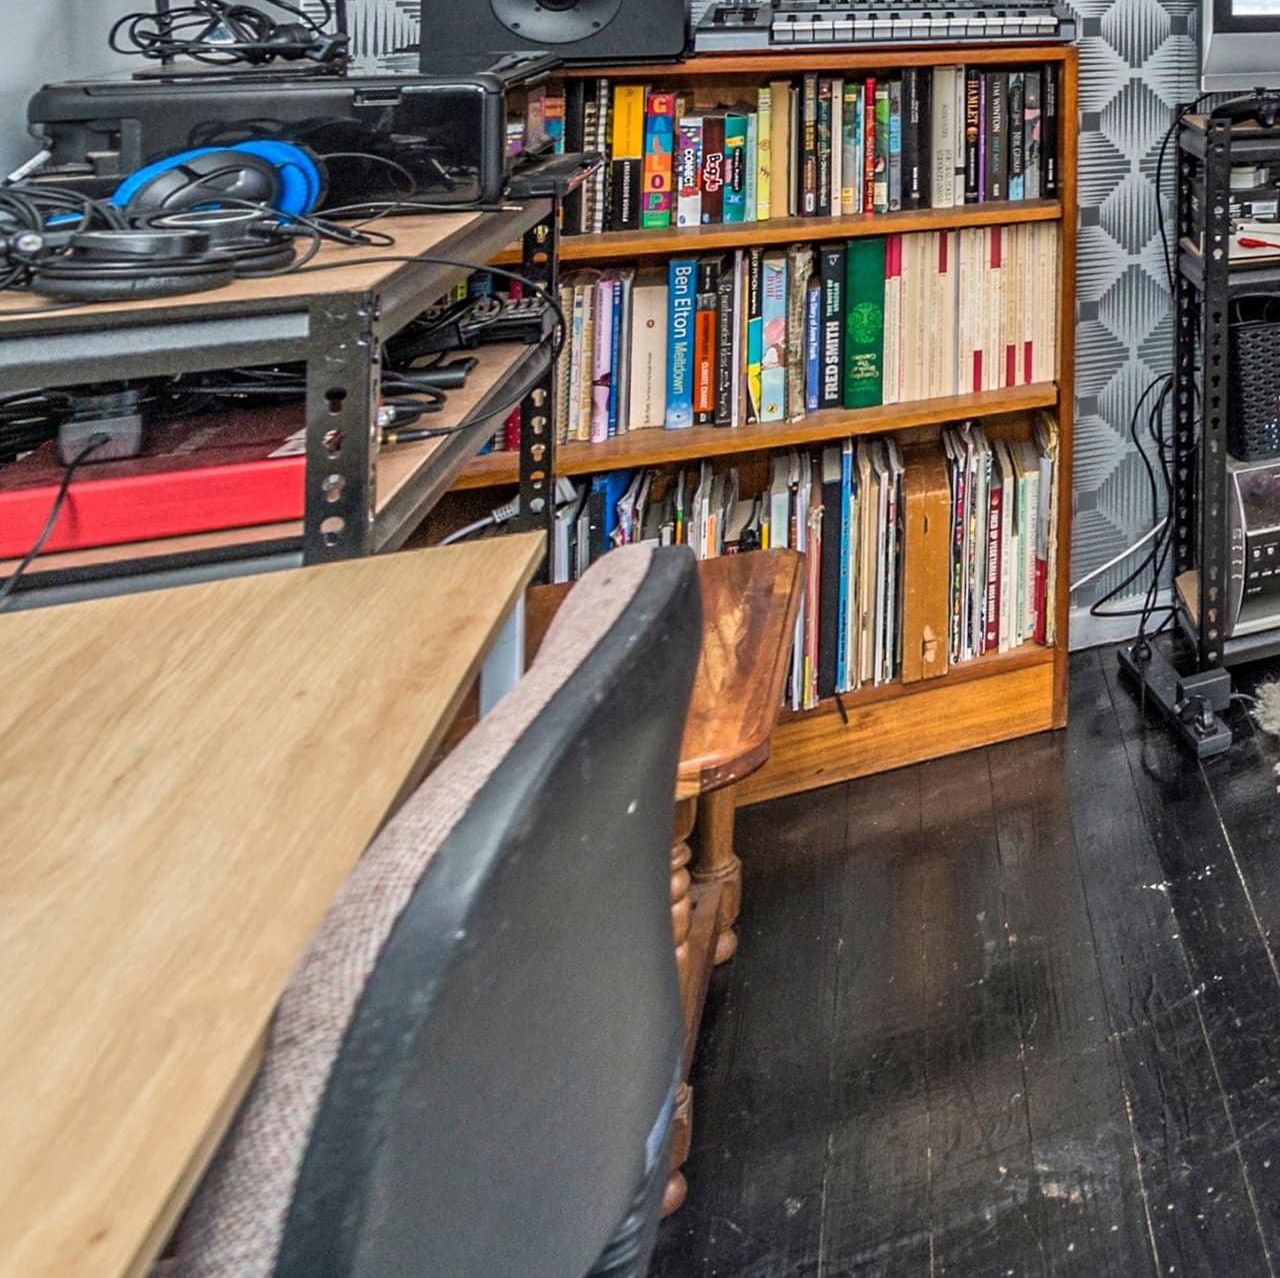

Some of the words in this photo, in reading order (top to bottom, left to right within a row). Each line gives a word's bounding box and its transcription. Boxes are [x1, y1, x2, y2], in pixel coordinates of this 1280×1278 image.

[967, 79, 979, 126] HAMLET
[991, 80, 1001, 97] TIM
[991, 98, 1001, 133] WINTON
[684, 148, 695, 187] CONNECT
[703, 152, 723, 192] Boggle
[674, 266, 691, 295] Ben
[775, 270, 784, 300] ROALD
[809, 290, 818, 303] The
[673, 297, 691, 338] Elton
[720, 294, 732, 346] mathematical
[809, 303, 818, 319] Diary
[825, 320, 840, 364] SMITH
[671, 341, 687, 395] Meltdown
[700, 361, 709, 385] CLIMATE
[824, 363, 840, 400] FRED
[699, 386, 708, 409] CHANGE
[988, 539, 998, 582] VEGETARIAN
